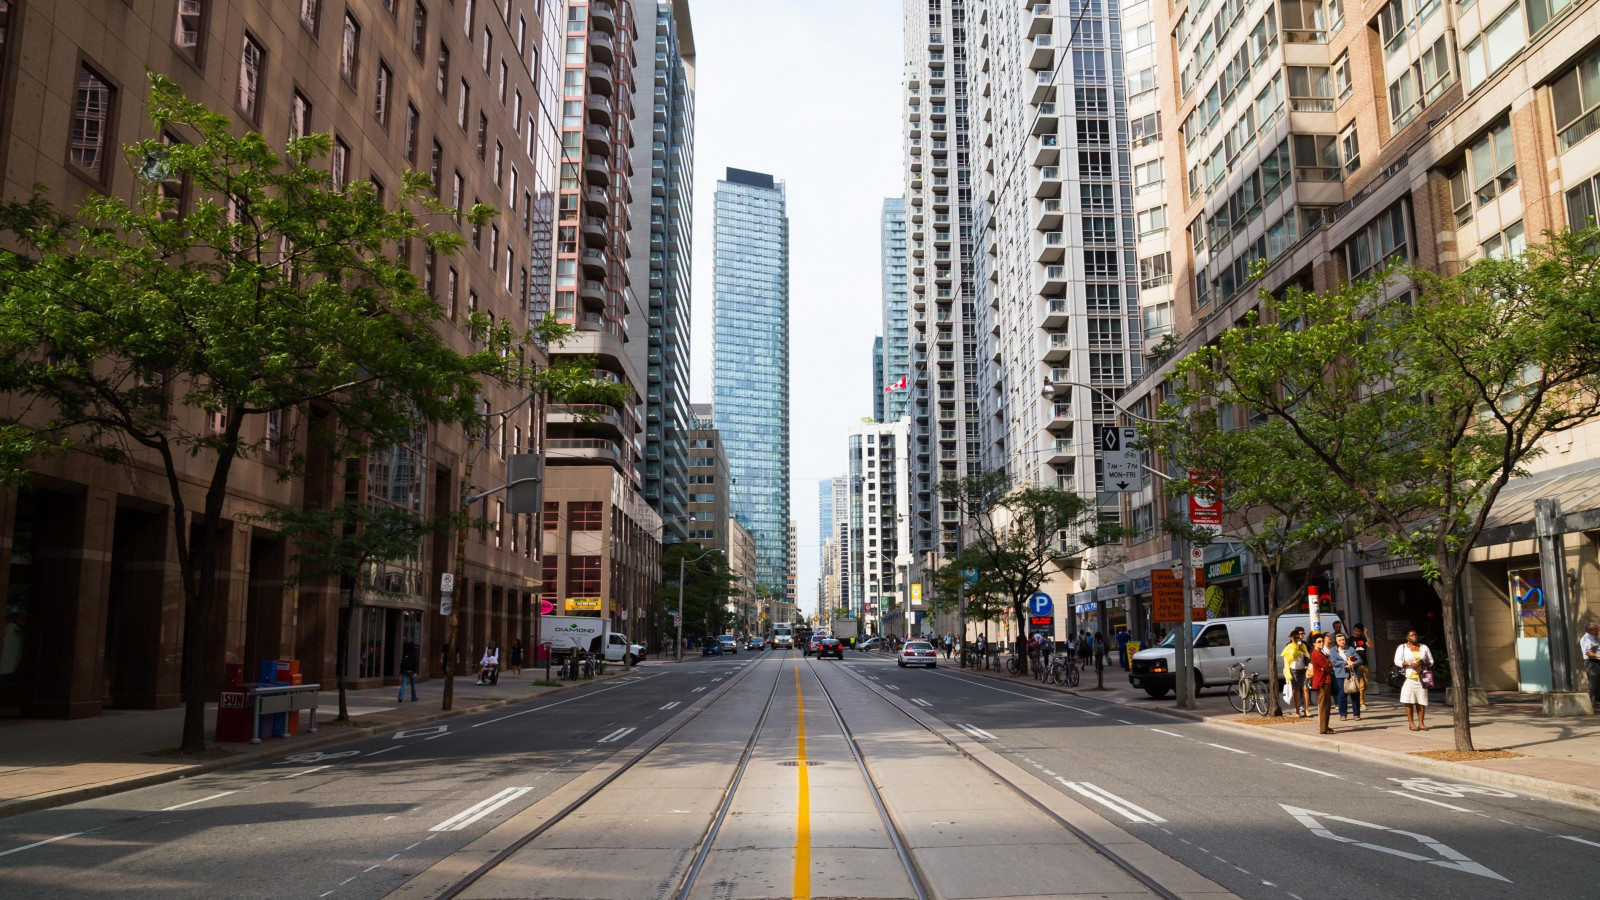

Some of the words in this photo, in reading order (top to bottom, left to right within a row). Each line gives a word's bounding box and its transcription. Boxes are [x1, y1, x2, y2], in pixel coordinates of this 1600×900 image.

[1208, 559, 1235, 578] SUBWAY
[1035, 596, 1048, 612] P
[224, 693, 243, 706] SUN
